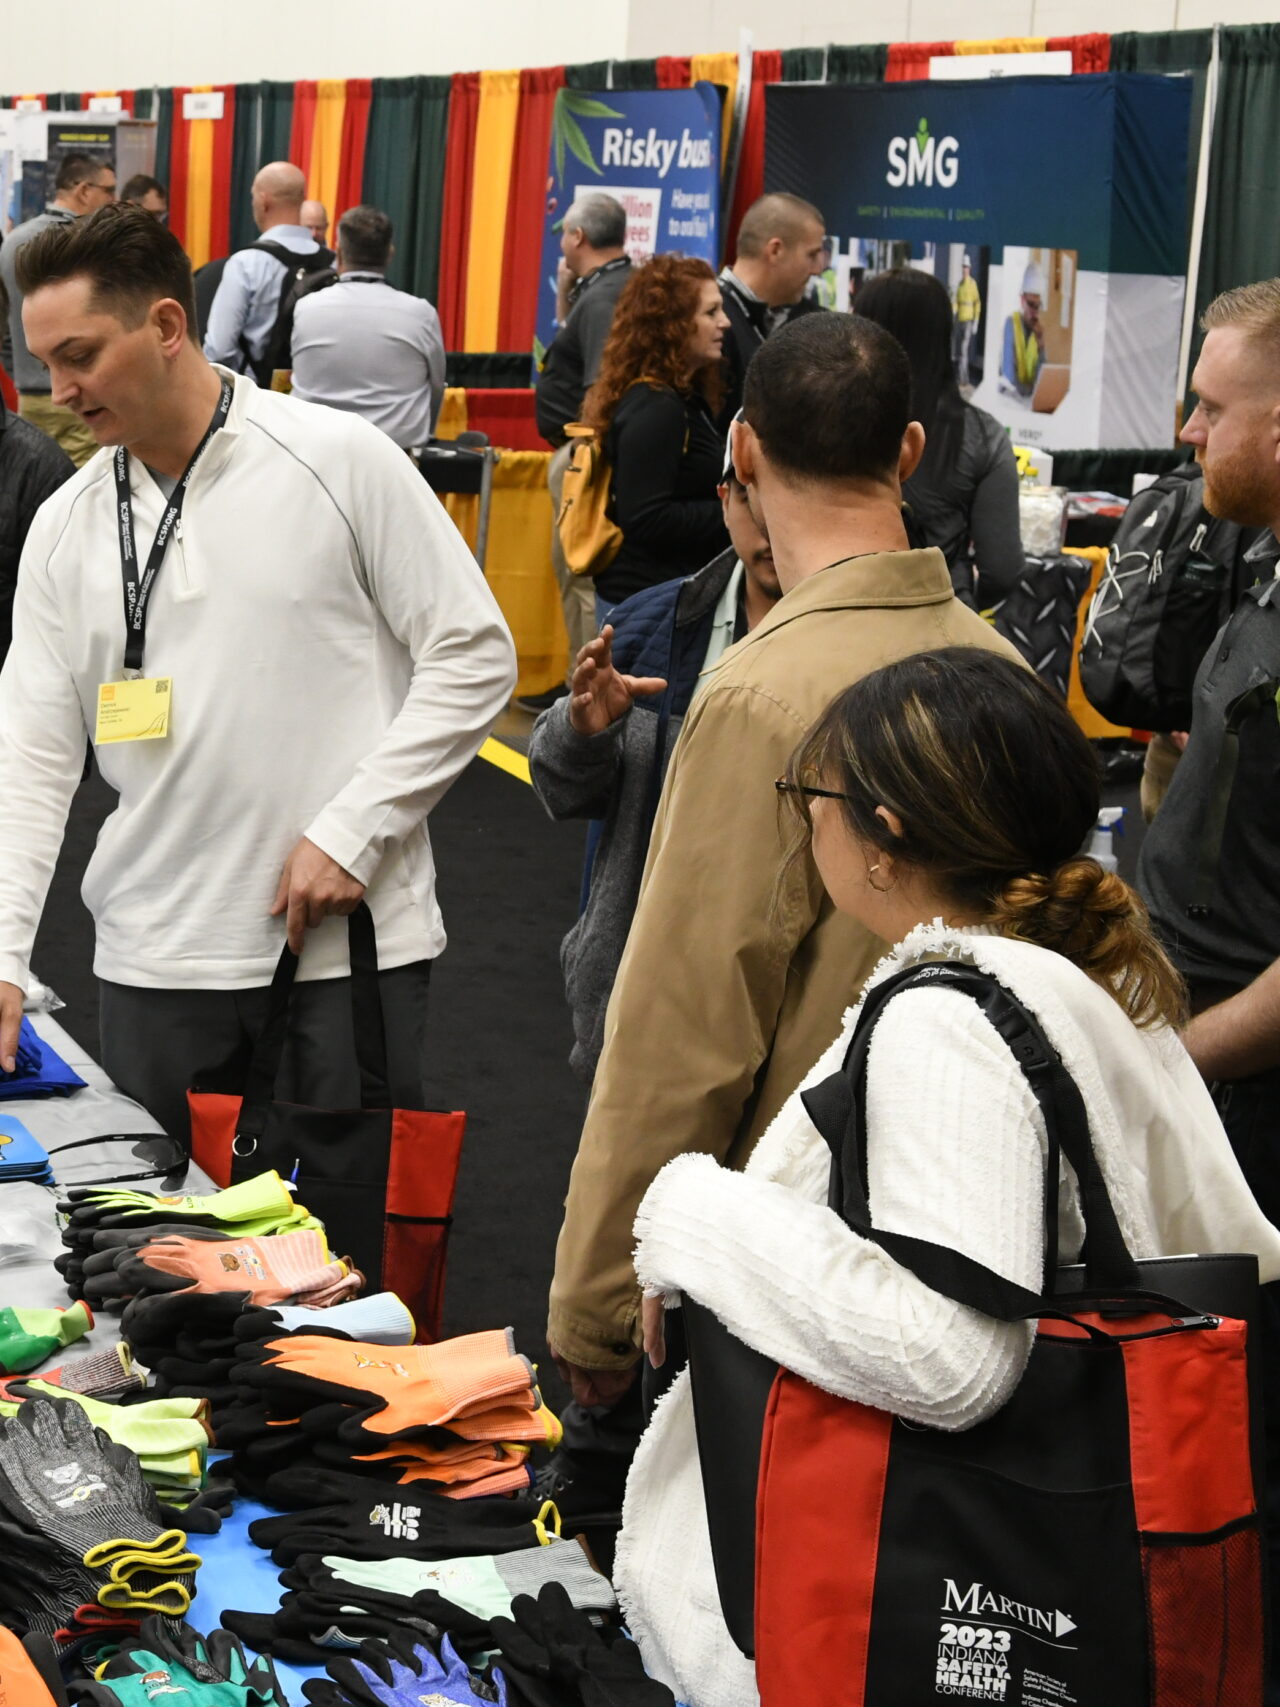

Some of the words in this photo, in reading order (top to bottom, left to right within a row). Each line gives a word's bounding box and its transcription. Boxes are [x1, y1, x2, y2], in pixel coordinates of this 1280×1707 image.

[602, 127, 678, 179] Risky
[886, 136, 960, 188] SMG
[121, 501, 129, 524] BCSP
[157, 507, 178, 546] BCSP.ORG
[133, 606, 143, 630] BCSP
[940, 1578, 1054, 1633] MARTIN
[938, 1623, 1012, 1653] 2023
[937, 1644, 1008, 1665] INDIANA
[936, 1657, 1008, 1679] SAFETY
[935, 1670, 1007, 1692] HEALTH
[935, 1684, 1006, 1702] CONFERENCE
